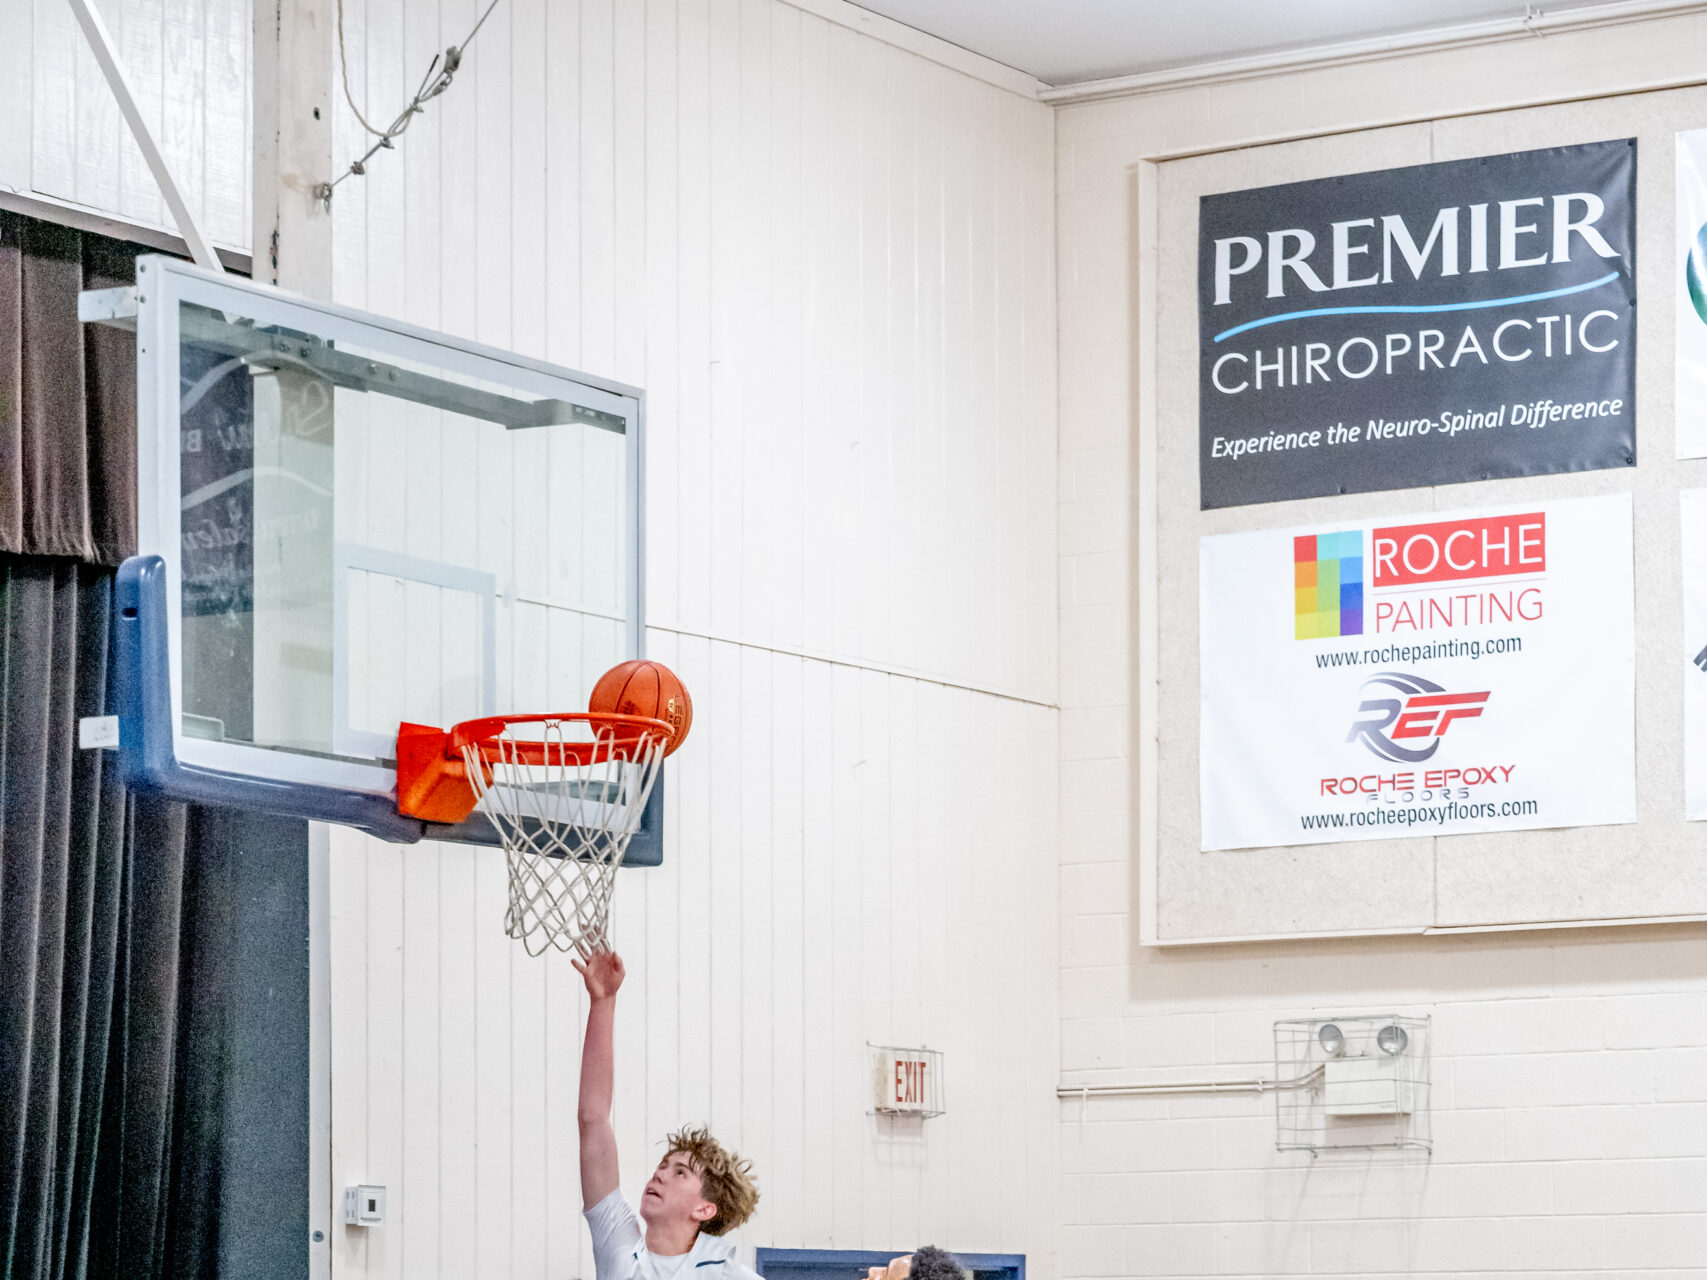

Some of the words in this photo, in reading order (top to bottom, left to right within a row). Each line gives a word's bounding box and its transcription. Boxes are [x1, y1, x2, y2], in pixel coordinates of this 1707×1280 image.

[1213, 192, 1621, 305] PREMIER
[1211, 310, 1620, 394] CHIROPRACTIC
[1211, 431, 1321, 461] Experience
[1327, 422, 1361, 445] the
[1366, 405, 1506, 441] Neuro-Spinal
[1511, 397, 1624, 429] Difference
[1374, 523, 1543, 579] ROCHE
[1375, 588, 1543, 634] PAINTING
[1315, 635, 1523, 669] www.rochepainting.com
[1345, 691, 1490, 744] REF
[1320, 772, 1415, 797] ROCHE
[1424, 765, 1516, 789] EPOXY
[1367, 787, 1470, 804] FLOORS
[1300, 799, 1539, 830] www.rocheepoxyfloors.com
[895, 1060, 926, 1104] EXIT
